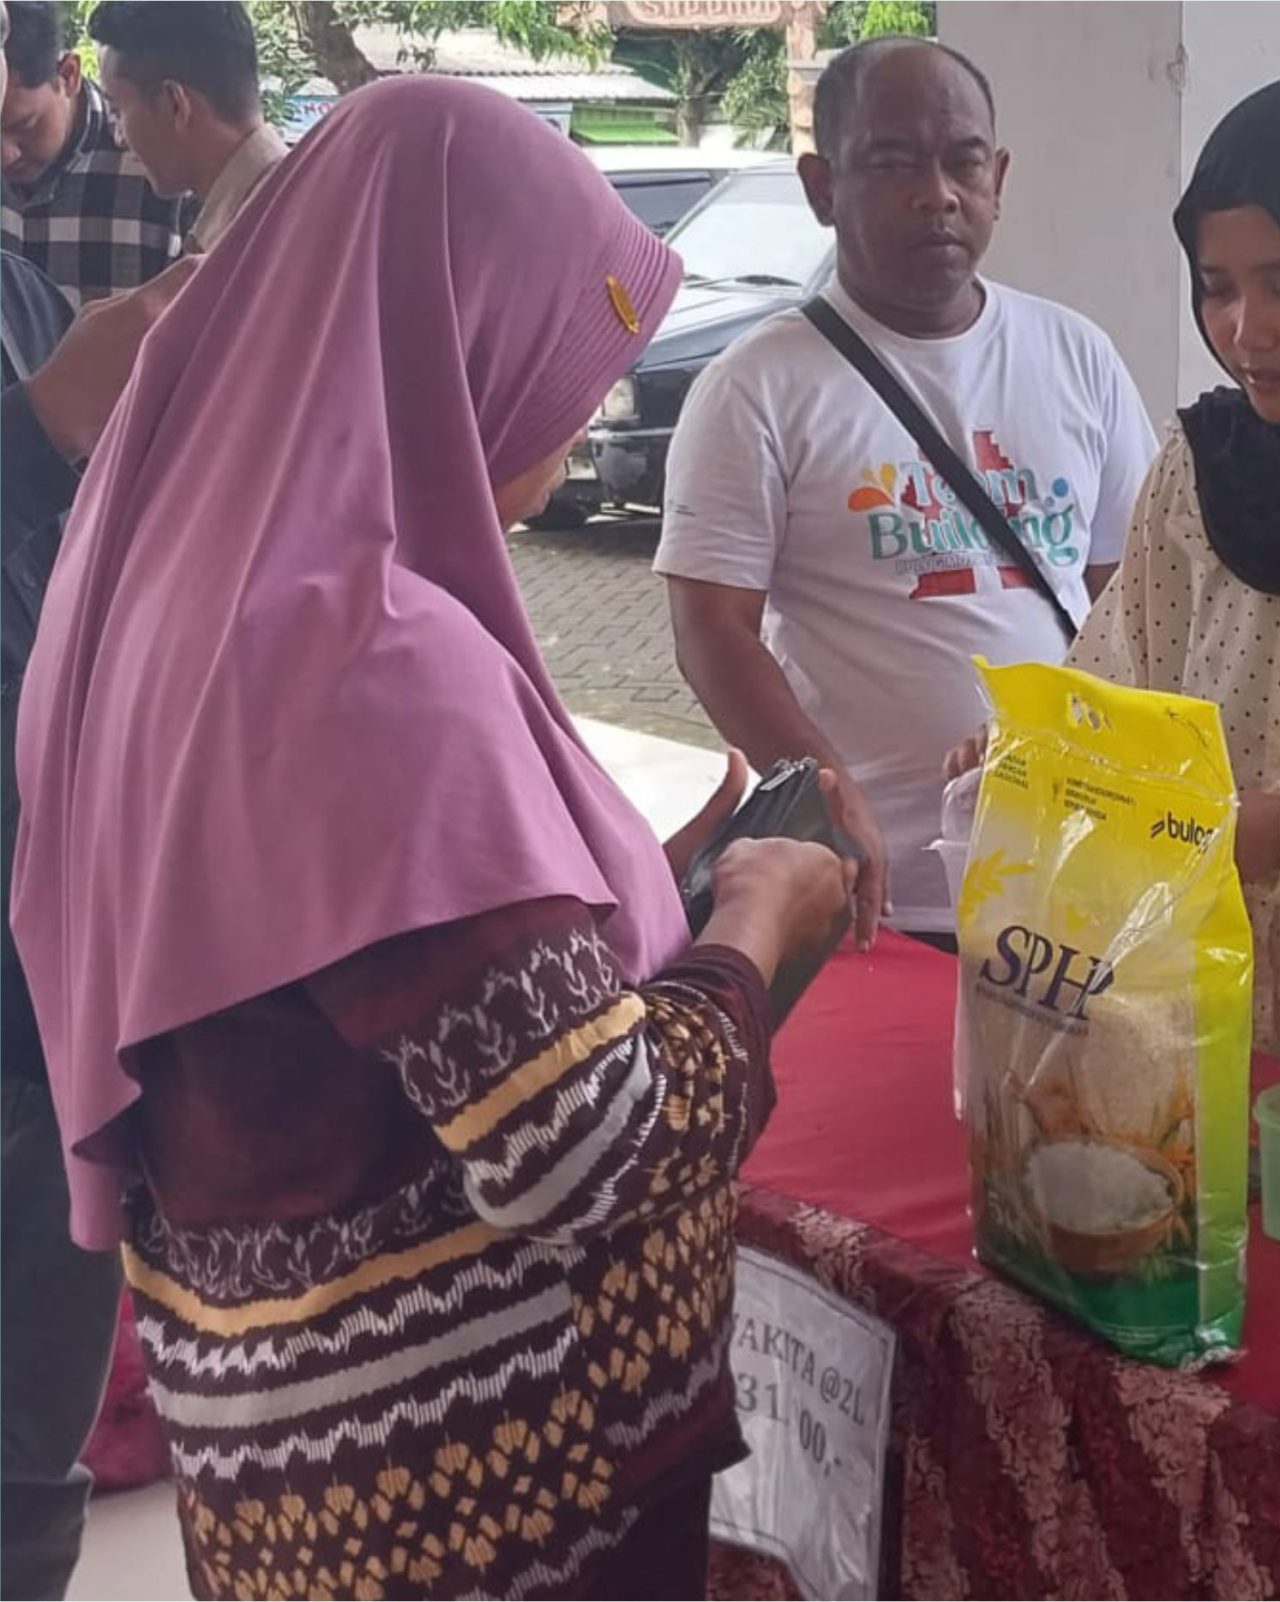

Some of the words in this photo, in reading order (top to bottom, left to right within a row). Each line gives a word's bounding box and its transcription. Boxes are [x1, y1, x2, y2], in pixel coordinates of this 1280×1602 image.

[900, 461, 1039, 506] Tem
[867, 502, 1079, 567] Builng
[978, 924, 1115, 1021] SPHP
[734, 1313, 816, 1388] AKITA
[820, 1365, 865, 1427] @2L
